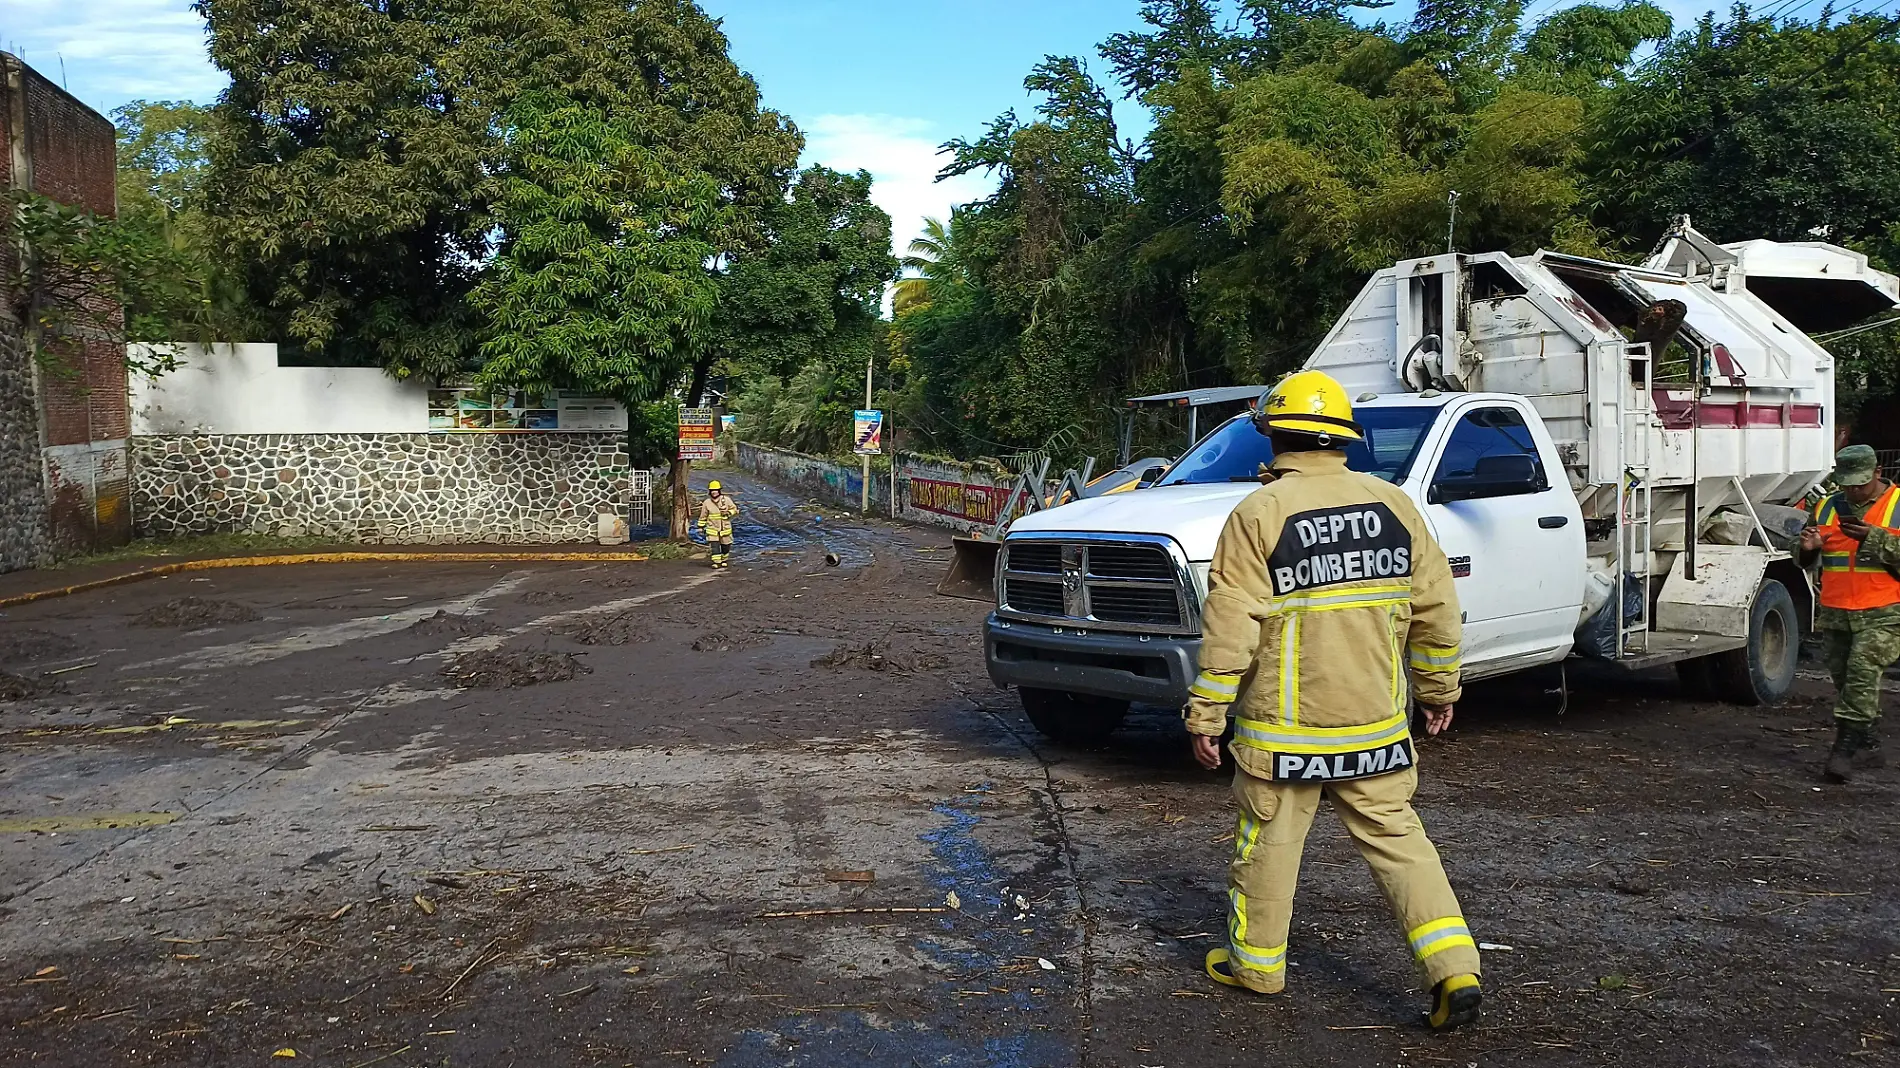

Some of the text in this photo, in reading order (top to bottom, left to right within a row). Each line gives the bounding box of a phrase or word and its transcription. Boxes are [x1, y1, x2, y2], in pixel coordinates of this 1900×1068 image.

[1294, 510, 1382, 548] DEPTO
[1274, 547, 1409, 594] BOMBEROS
[1278, 743, 1410, 779] PALMA
